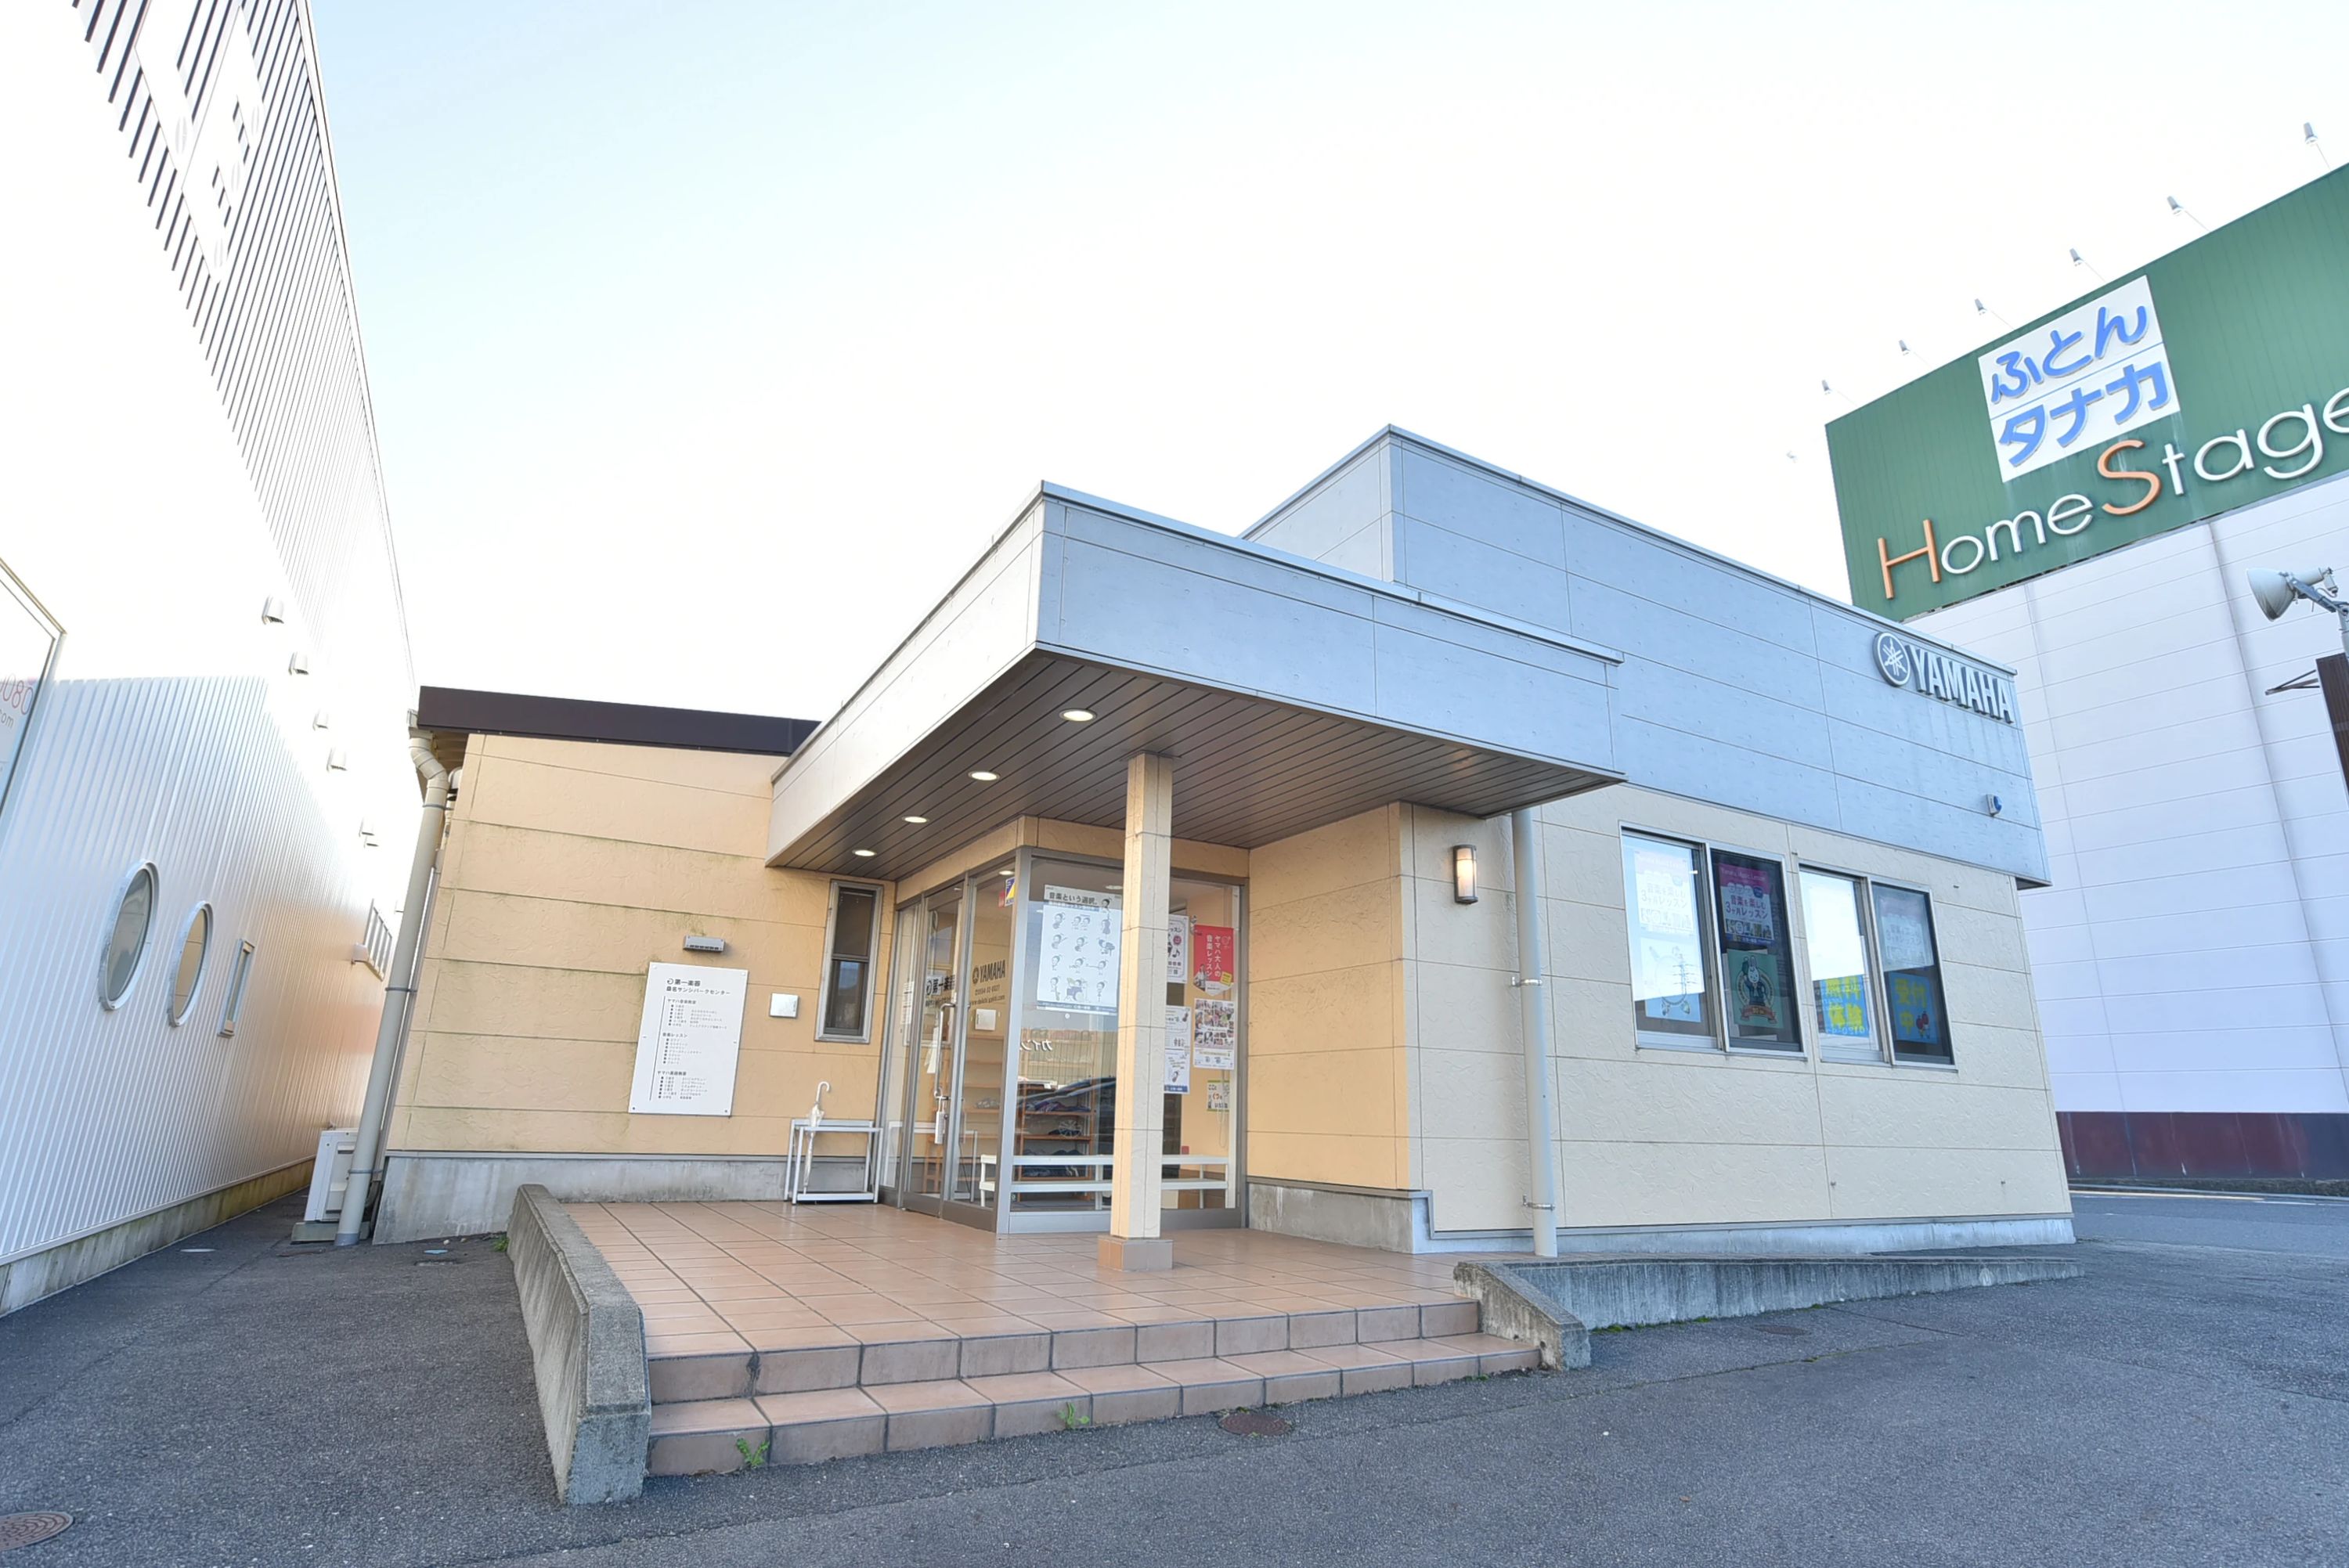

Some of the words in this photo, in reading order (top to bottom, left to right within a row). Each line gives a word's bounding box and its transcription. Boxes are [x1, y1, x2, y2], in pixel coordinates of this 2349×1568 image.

[1990, 305, 2148, 403] ふとん
[2000, 359, 2170, 468] タナカ
[1905, 644, 2015, 724] YAMAHA
[674, 979, 701, 987] 第一楽器
[980, 959, 1005, 983] YAMAHA
[1894, 978, 1928, 1009] 受付
[1900, 1009, 1914, 1036] 中
